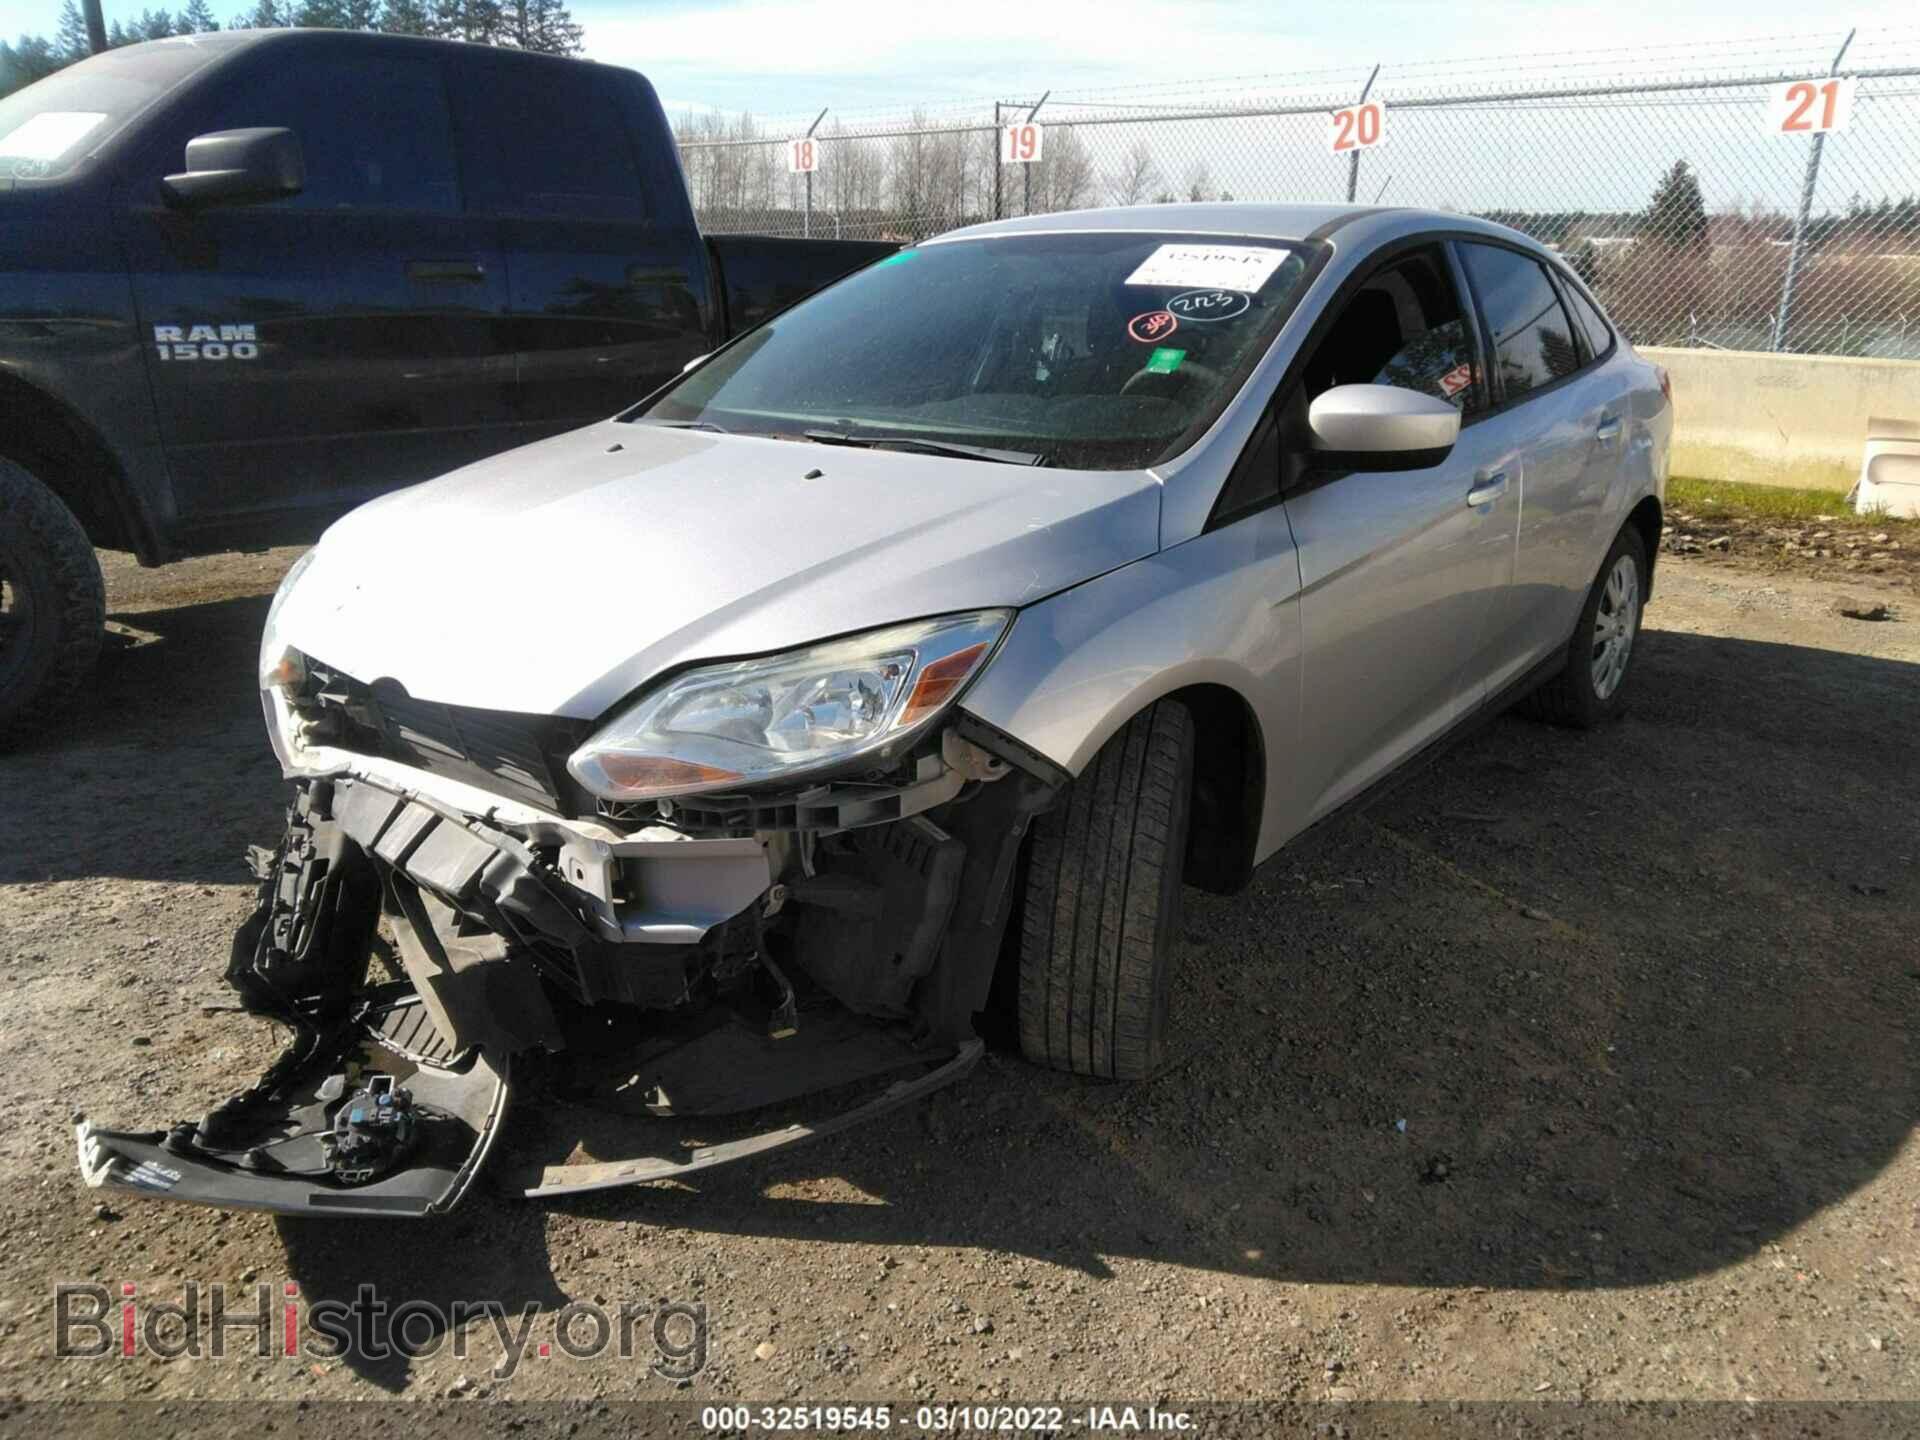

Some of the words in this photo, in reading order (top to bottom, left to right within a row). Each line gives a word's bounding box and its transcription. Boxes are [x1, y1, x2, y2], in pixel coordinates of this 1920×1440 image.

[1781, 81, 1840, 131] 21
[1333, 104, 1380, 151] 20
[793, 141, 813, 170] 18
[1009, 127, 1036, 160] 19
[154, 325, 257, 341] RAM
[157, 343, 258, 360] 1500
